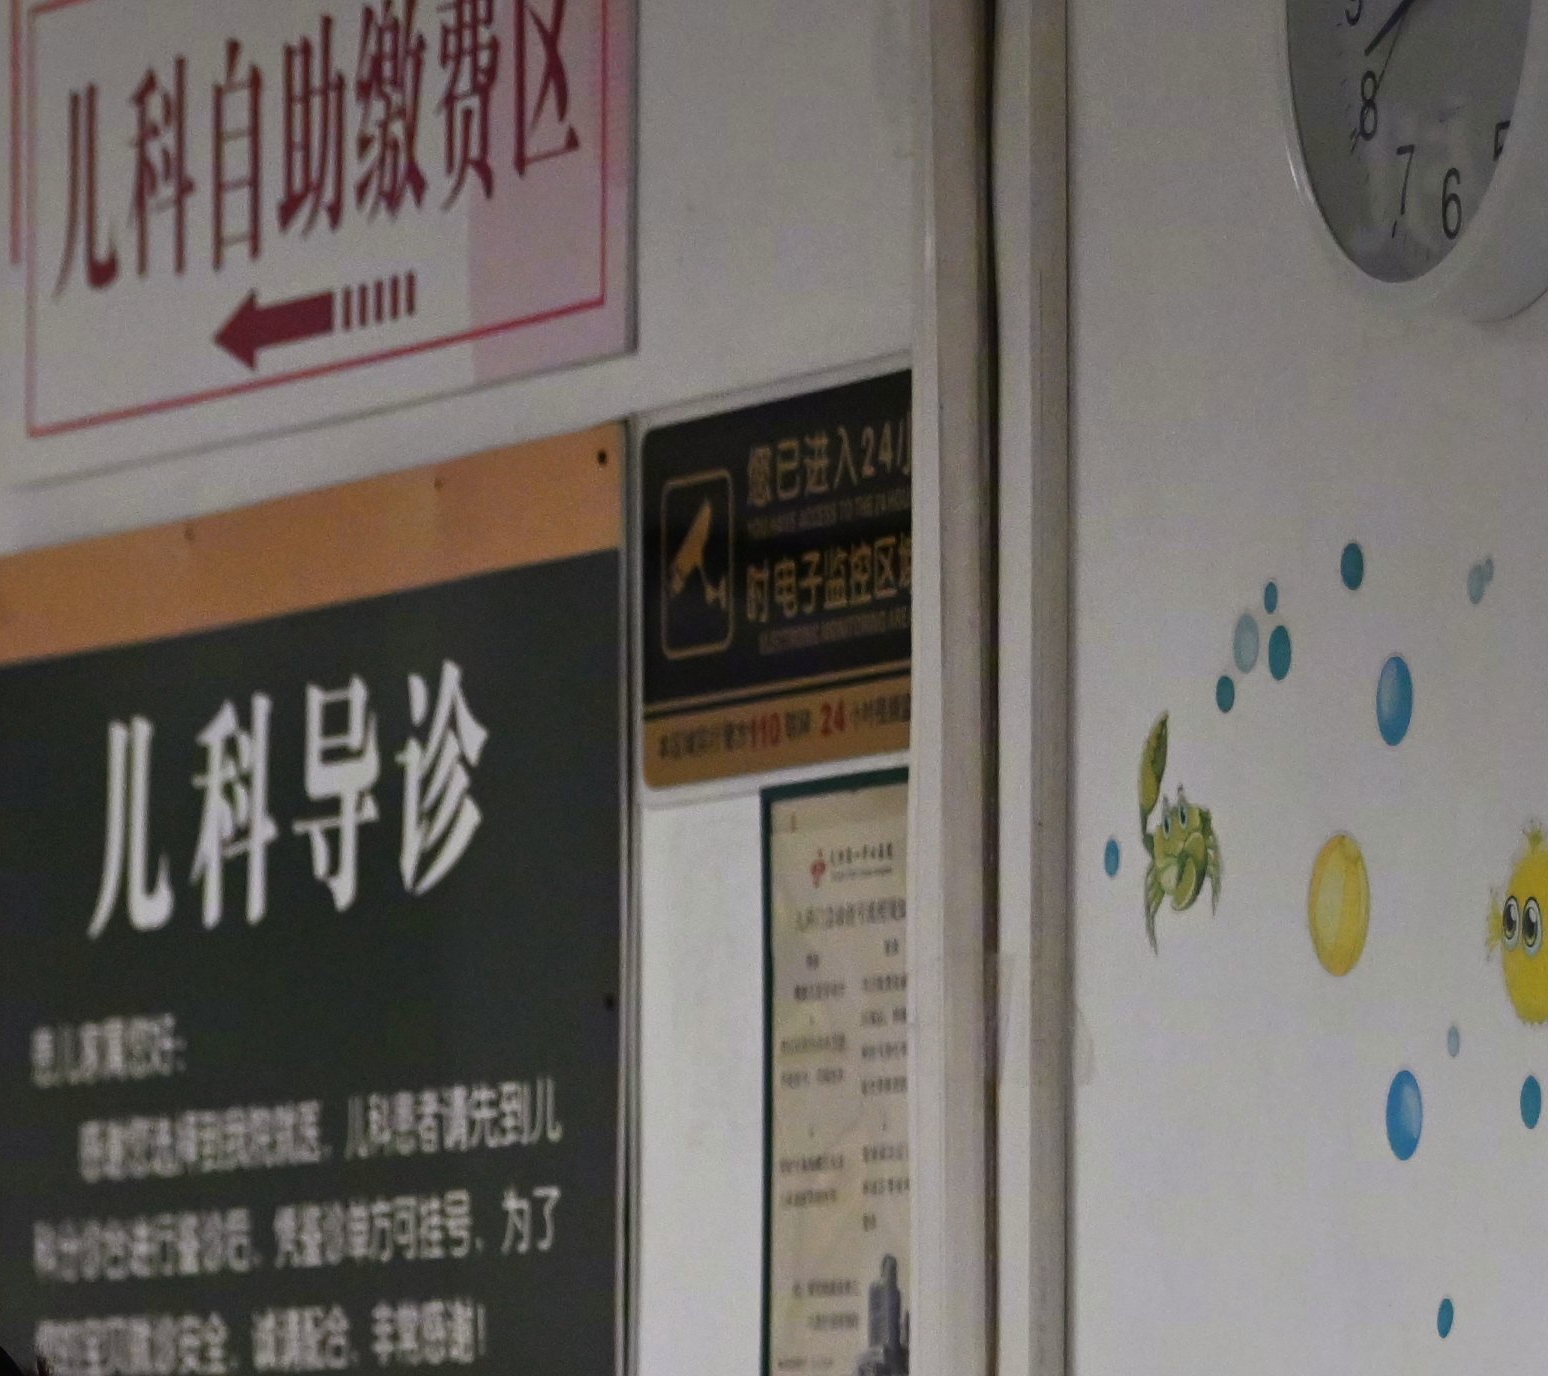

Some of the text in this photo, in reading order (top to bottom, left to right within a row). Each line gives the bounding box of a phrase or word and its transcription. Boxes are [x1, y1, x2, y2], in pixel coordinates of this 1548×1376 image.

[1359, 70, 1378, 141] 8
[51, 0, 580, 298] 儿科自助缴费区
[1396, 144, 1415, 216] 7
[1442, 167, 1462, 240] 6
[88, 658, 489, 939] 儿科导诊
